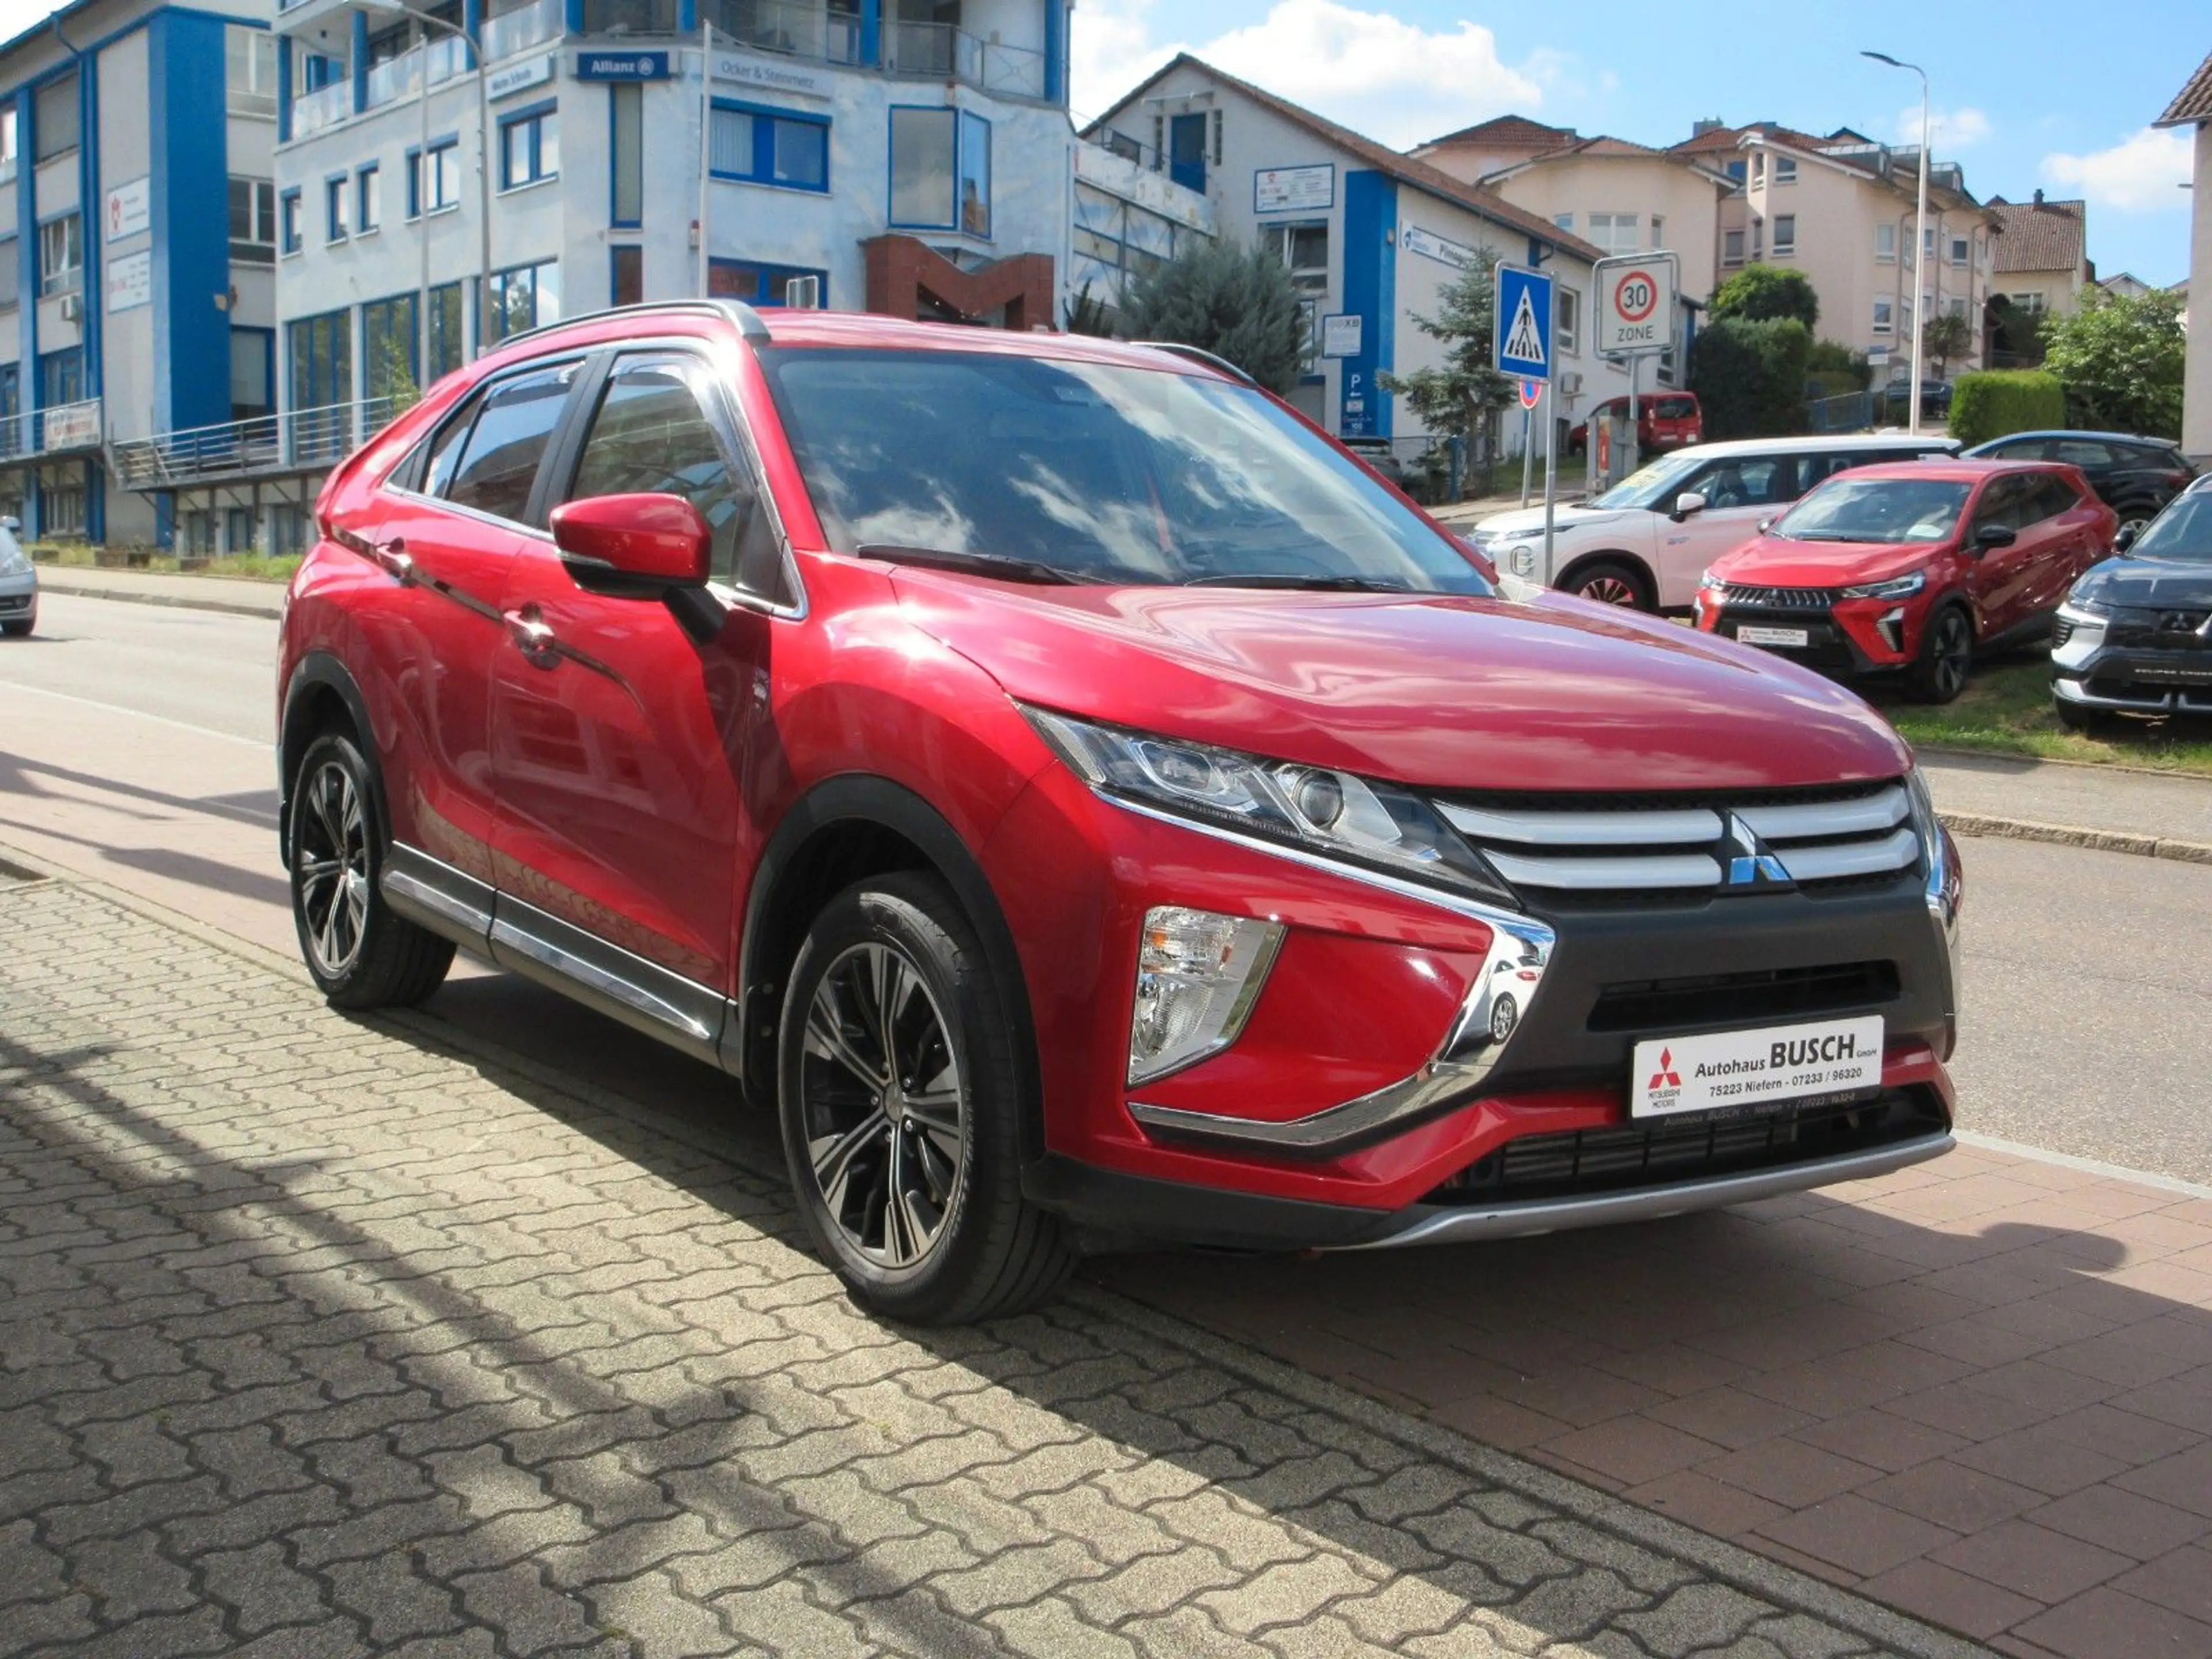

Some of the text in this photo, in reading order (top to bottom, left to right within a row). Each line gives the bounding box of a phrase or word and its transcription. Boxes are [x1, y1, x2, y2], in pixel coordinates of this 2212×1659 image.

[592, 59, 636, 73] Allianz
[1624, 284, 1647, 309] 30
[1618, 325, 1654, 342] ZONE
[1351, 374, 1361, 388] P
[1695, 1059, 1766, 1078] Autohaus
[1770, 1033, 1855, 1069] BUSCH
[1710, 1082, 1743, 1097] 75223
[1745, 1079, 1782, 1093] Niefern
[1792, 1072, 1823, 1086] 07233
[1832, 1067, 1862, 1081] 96320
